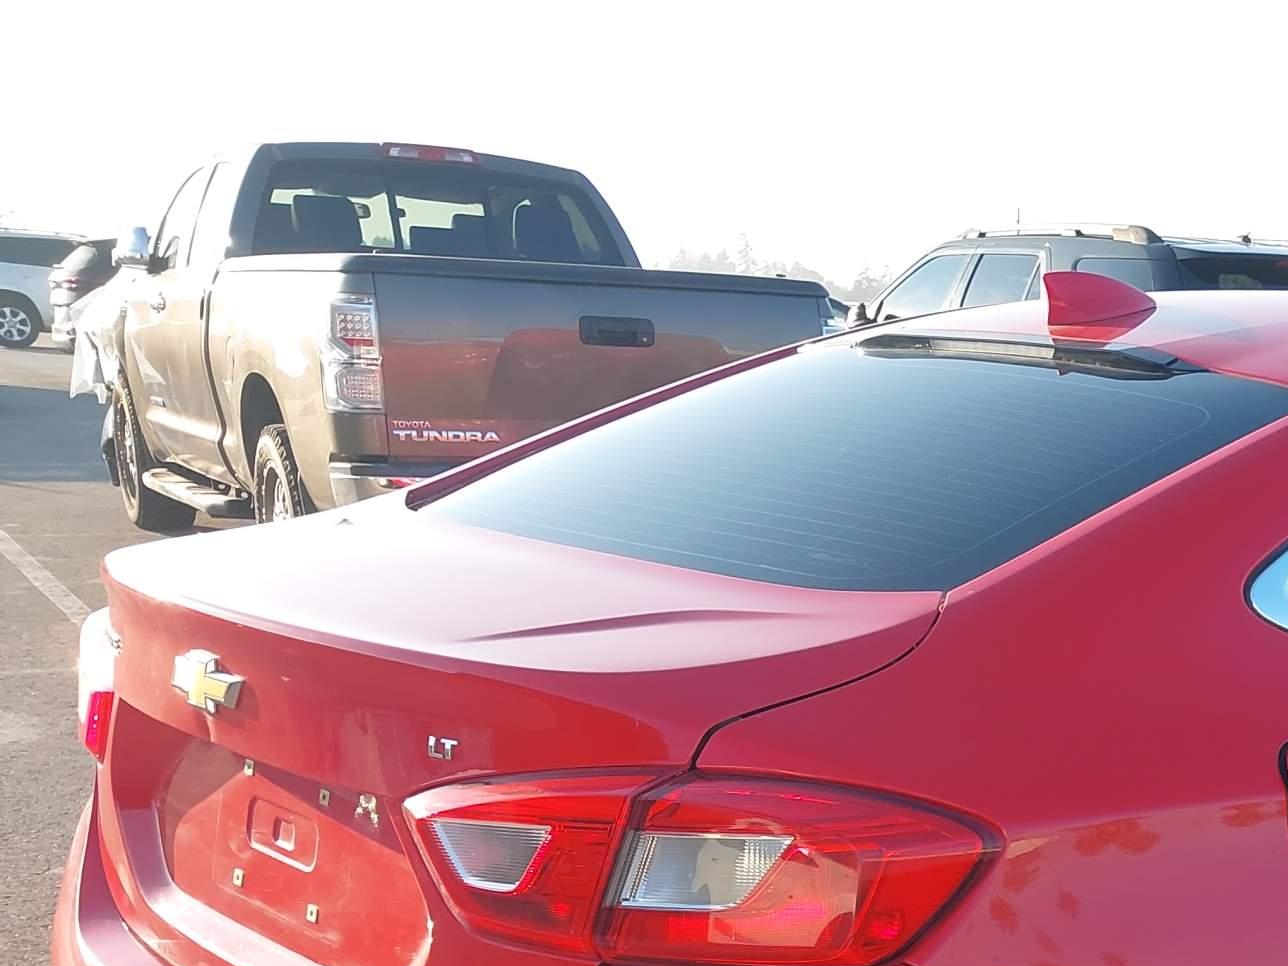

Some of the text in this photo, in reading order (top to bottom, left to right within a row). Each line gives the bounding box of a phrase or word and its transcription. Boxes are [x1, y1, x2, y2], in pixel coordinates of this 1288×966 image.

[392, 420, 431, 429] TOYOTA
[393, 430, 500, 442] TUNDRA
[428, 736, 458, 760] LT
